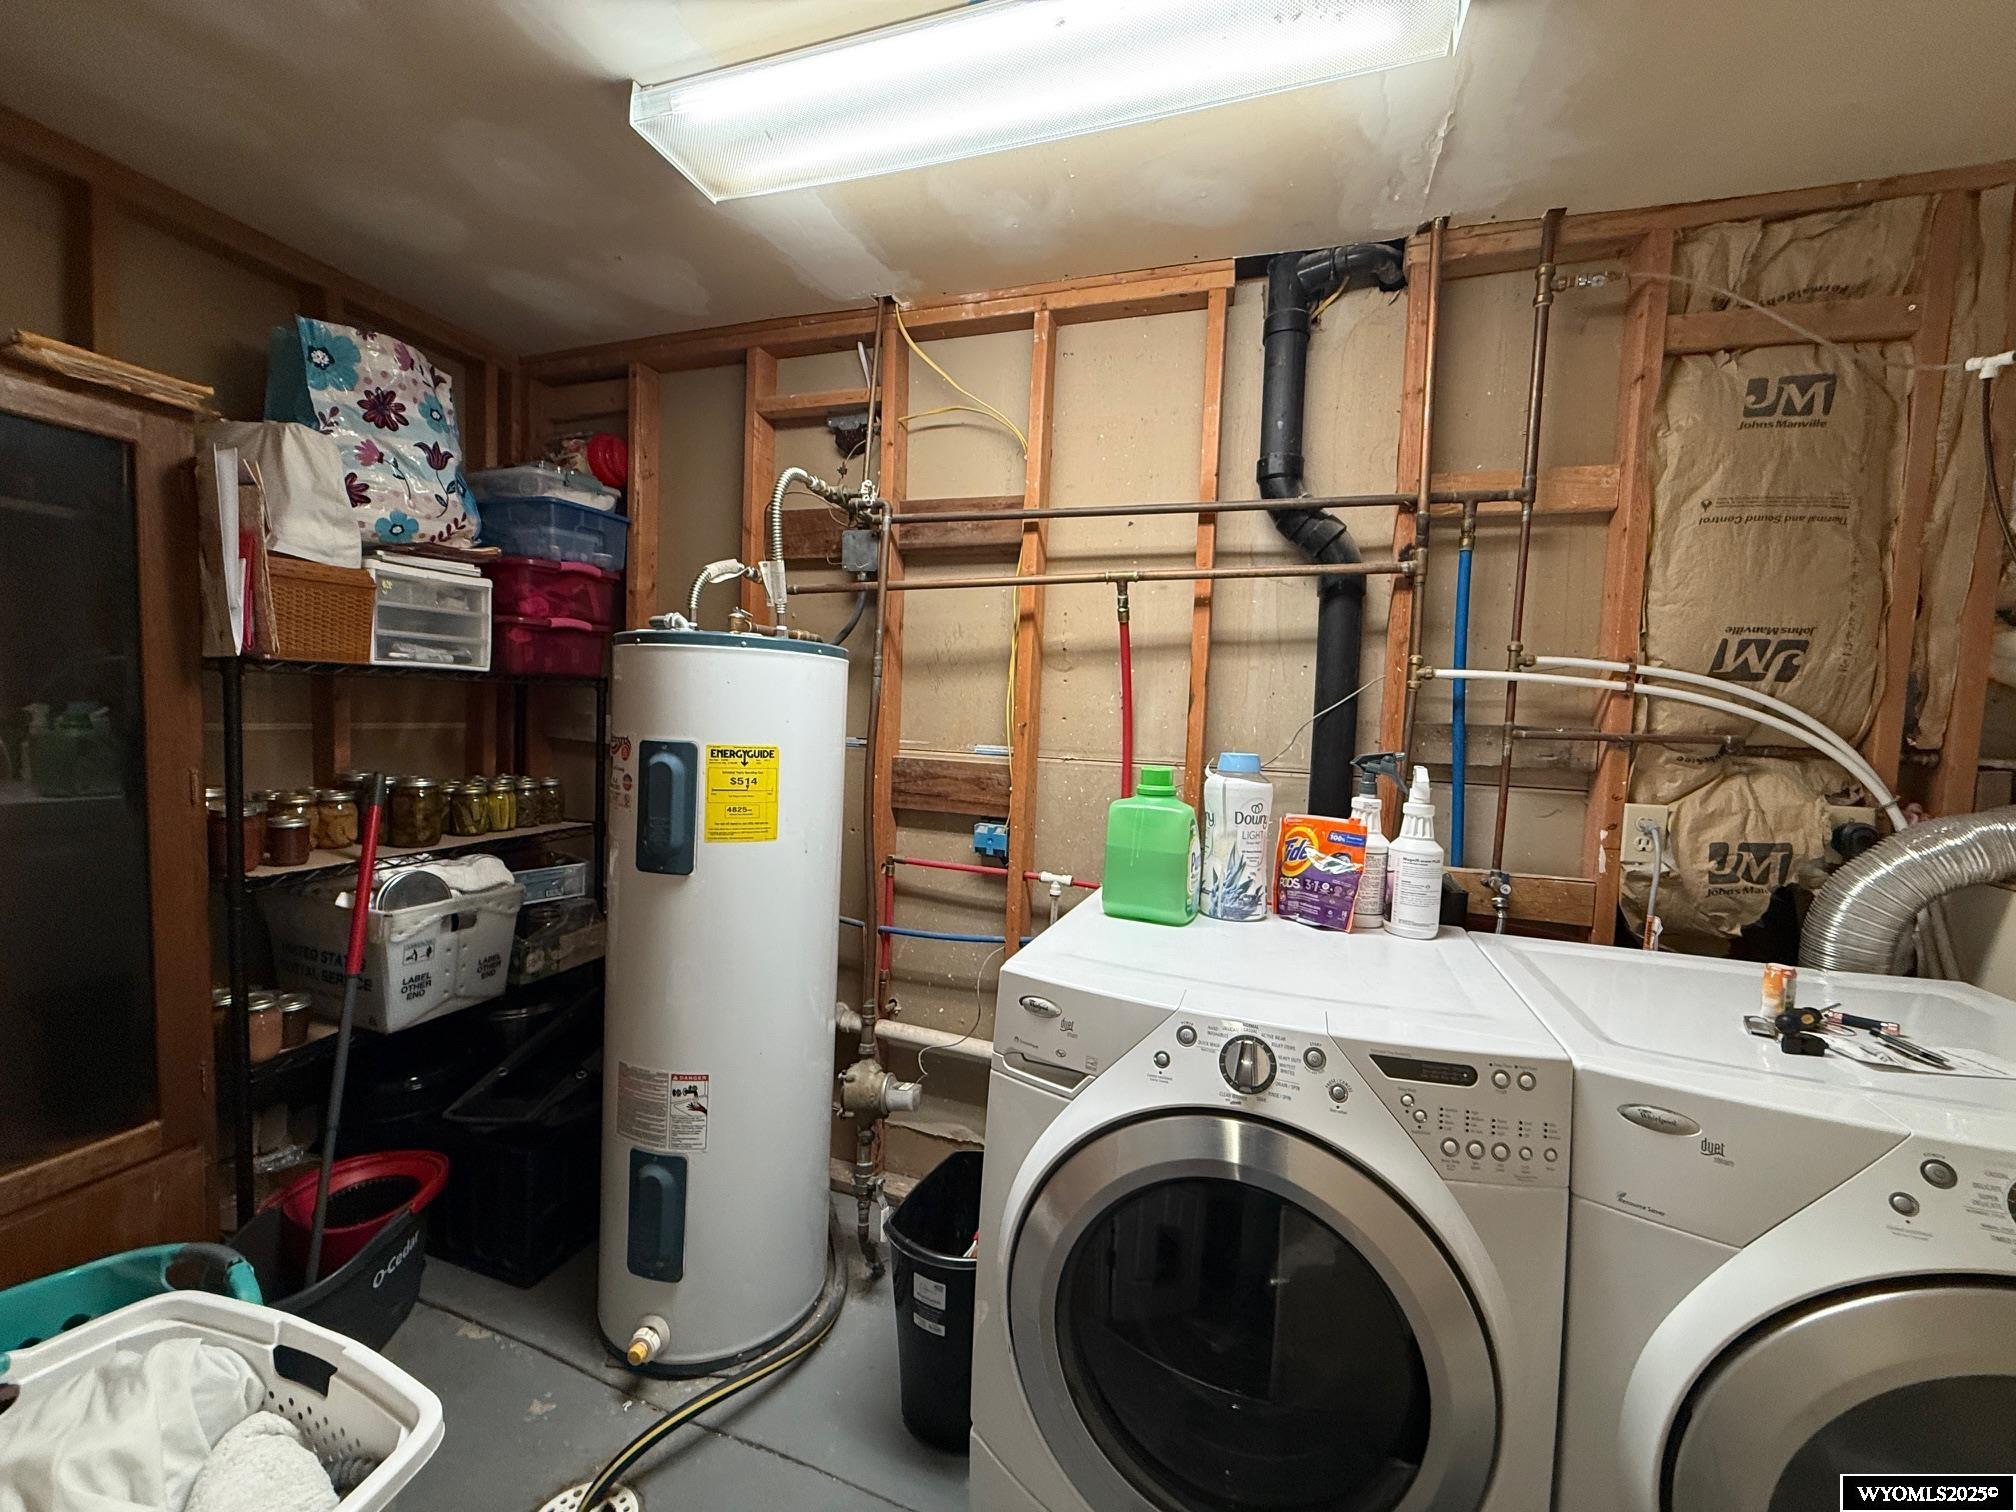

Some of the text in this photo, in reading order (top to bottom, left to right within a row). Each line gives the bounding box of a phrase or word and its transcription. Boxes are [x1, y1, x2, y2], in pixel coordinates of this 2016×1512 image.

[1742, 372, 1837, 418] JM
[1737, 418, 1828, 431] Johns Manville
[1698, 514, 1849, 526] Thermal and Sound Control
[1724, 625, 1816, 636] Johns Manville
[1707, 638, 1811, 682] JM
[711, 749, 775, 759] ENERGYGUIDE
[726, 805, 748, 813] 4825
[1242, 830, 1265, 841] LIGHT
[1285, 836, 1311, 862] Tide
[1708, 842, 1793, 885] JM
[1705, 887, 1741, 898] Johns
[478, 953, 502, 966] LABEL
[476, 960, 502, 974] OTHER
[401, 971, 432, 986] LABEL
[480, 969, 497, 980] END
[400, 979, 432, 994] OTHER
[406, 989, 426, 1001] END
[1700, 1137, 1726, 1157] duet
[372, 1230, 421, 1289] O-Cedar
